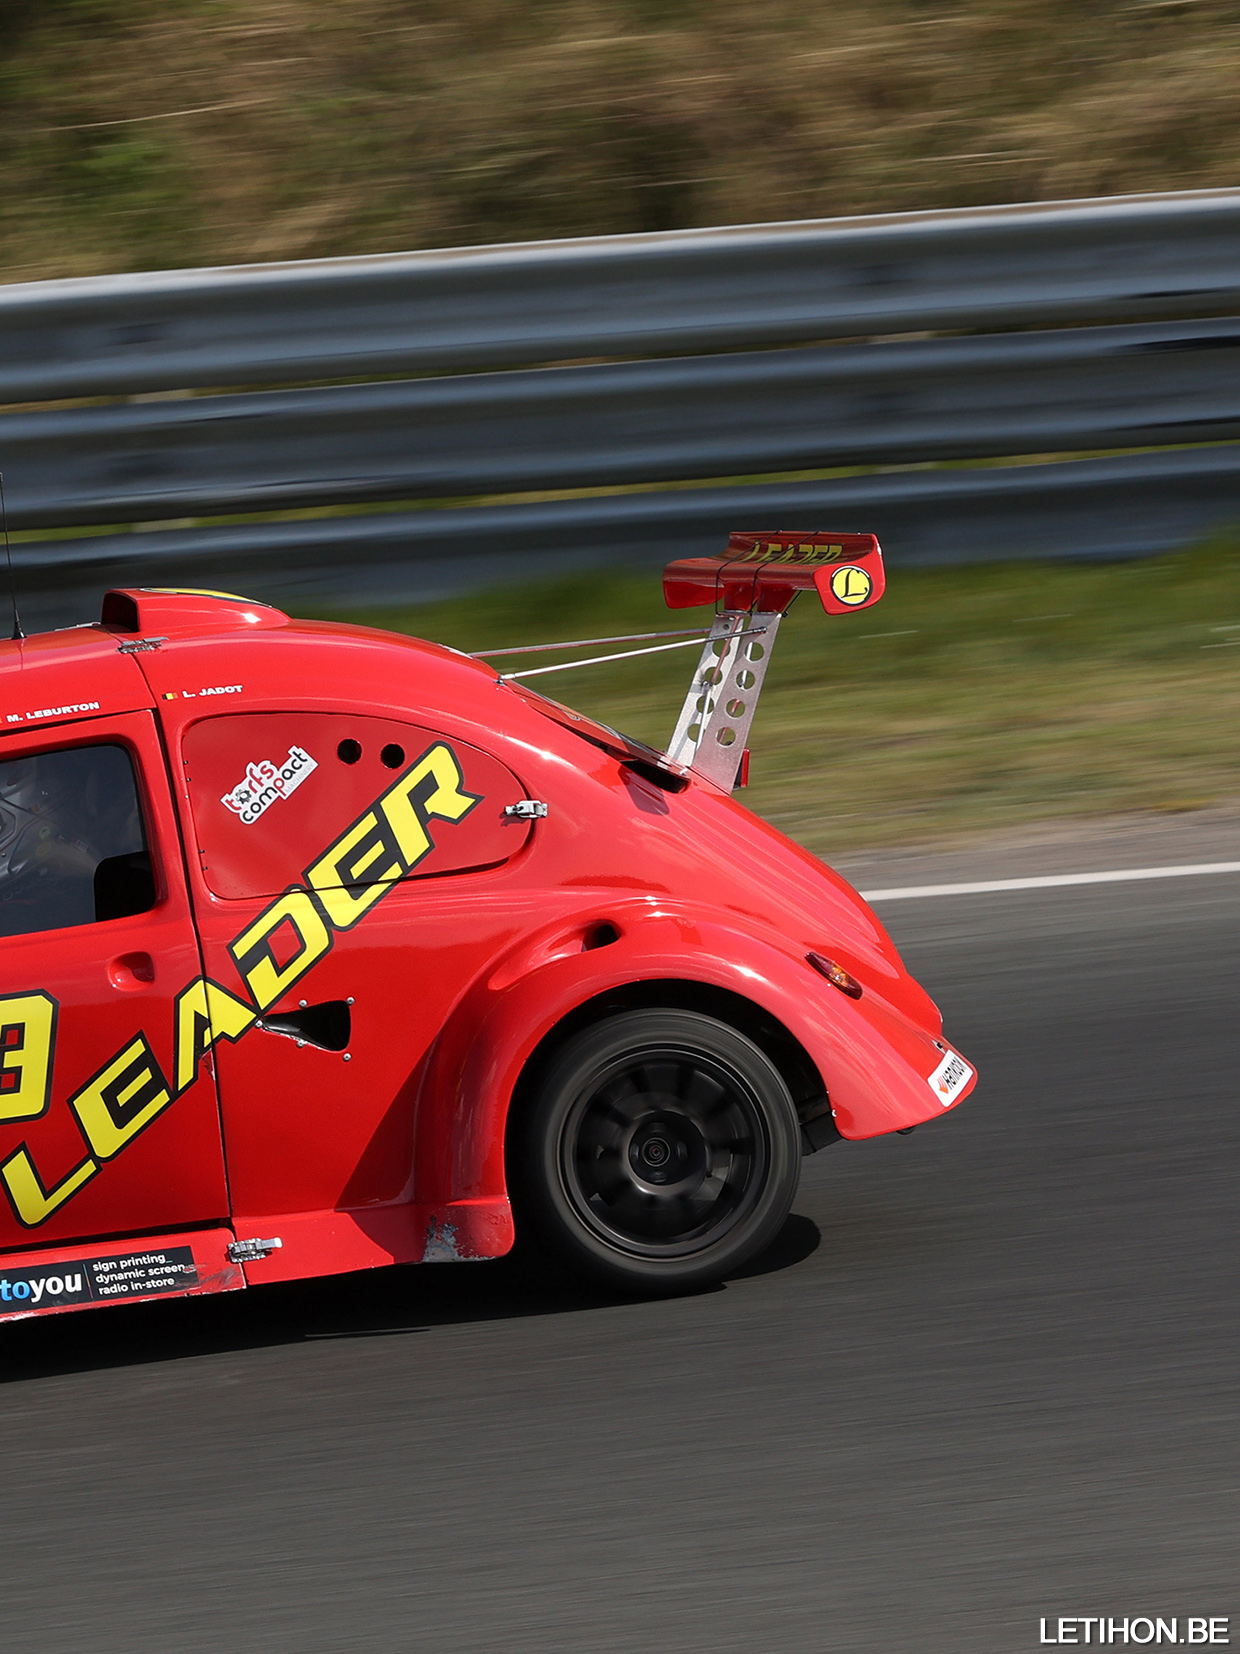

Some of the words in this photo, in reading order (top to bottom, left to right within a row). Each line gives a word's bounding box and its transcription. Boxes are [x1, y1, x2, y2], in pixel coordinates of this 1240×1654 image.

[182, 690, 196, 699] L.
[198, 685, 243, 697] JADOT
[6, 713, 24, 723] M.
[25, 701, 100, 720] LEBURTON
[242, 751, 308, 822] compact
[92, 1261, 118, 1272] sign
[95, 1268, 146, 1284] dynamic
[147, 1263, 185, 1276] screen
[98, 1283, 129, 1295] radio
[130, 1277, 175, 1291] in-store
